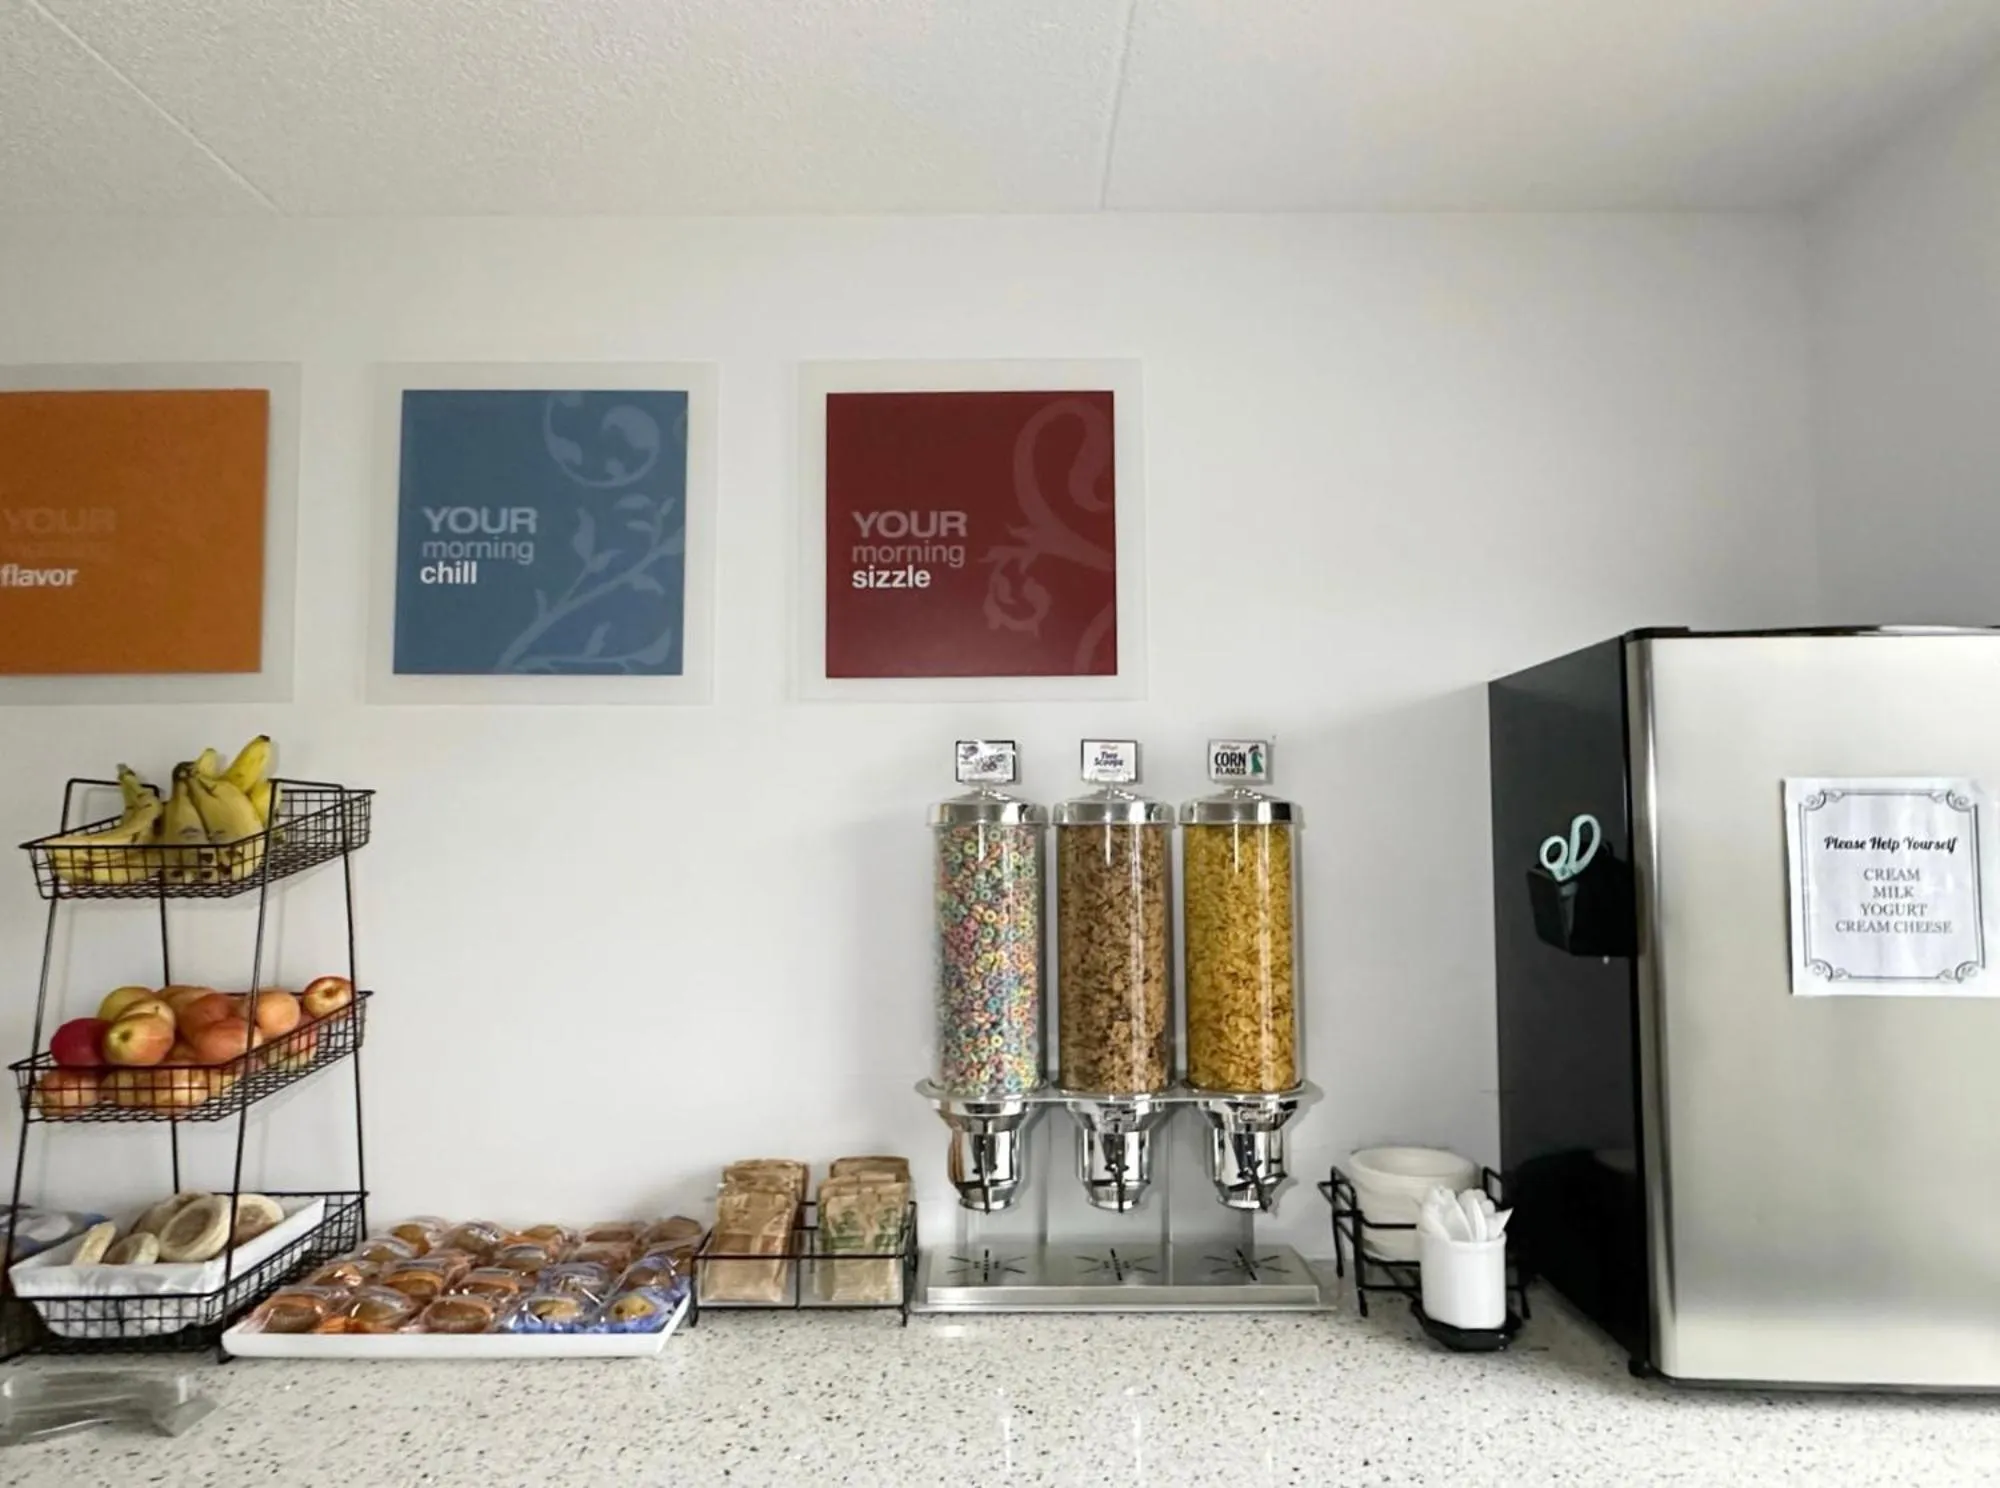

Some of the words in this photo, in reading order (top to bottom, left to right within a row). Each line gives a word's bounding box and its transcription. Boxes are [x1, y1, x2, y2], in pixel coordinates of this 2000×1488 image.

[422, 506, 538, 534] YOUR
[851, 510, 968, 538] YOUR
[422, 535, 535, 565] morning
[852, 540, 966, 568] morning
[420, 560, 477, 584] chill
[852, 564, 931, 588] sizzle
[1214, 751, 1246, 767] CORN
[1824, 836, 1867, 850] Please
[1868, 836, 1901, 854] Help
[1903, 836, 1957, 854] Yourself
[1863, 868, 1920, 881] CREAM
[1873, 886, 1914, 898] MILK
[1860, 902, 1927, 916] YOGURT
[1835, 919, 1890, 933] CREAM
[1893, 920, 1952, 933] CHEESE
